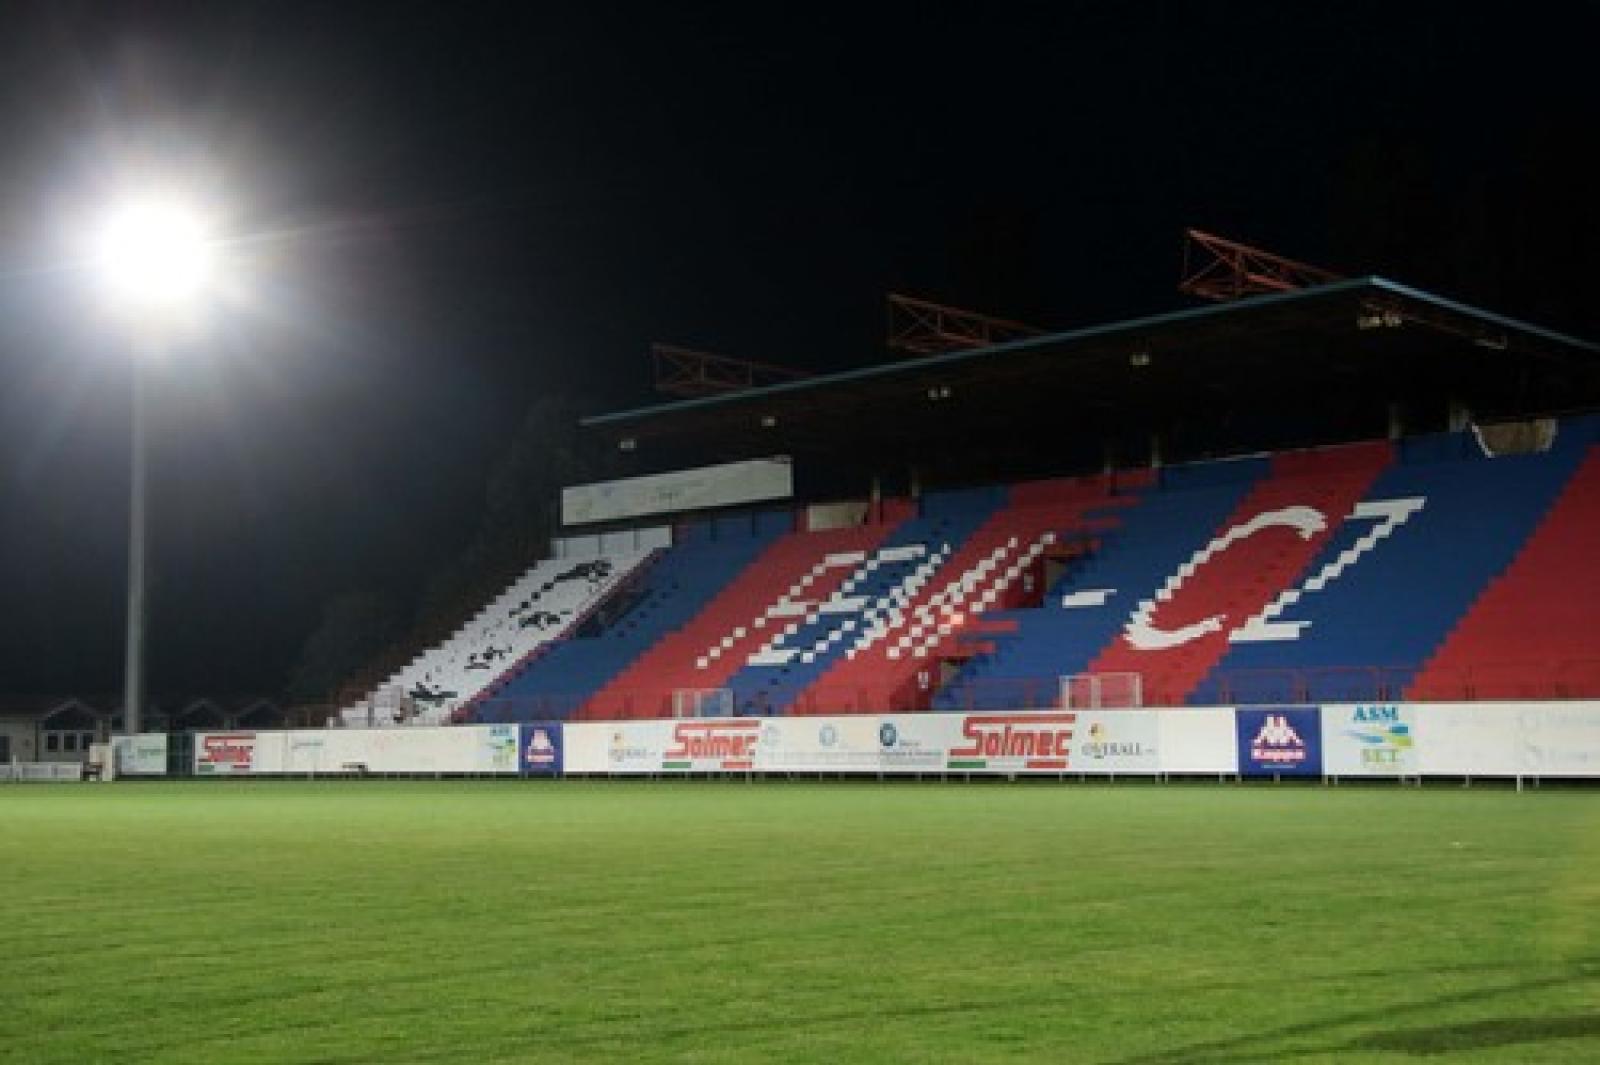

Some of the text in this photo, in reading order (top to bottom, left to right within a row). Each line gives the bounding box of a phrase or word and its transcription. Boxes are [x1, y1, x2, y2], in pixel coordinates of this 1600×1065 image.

[1353, 705, 1399, 721] ASM
[663, 720, 761, 759] Solmec
[949, 714, 1076, 757] Solmec
